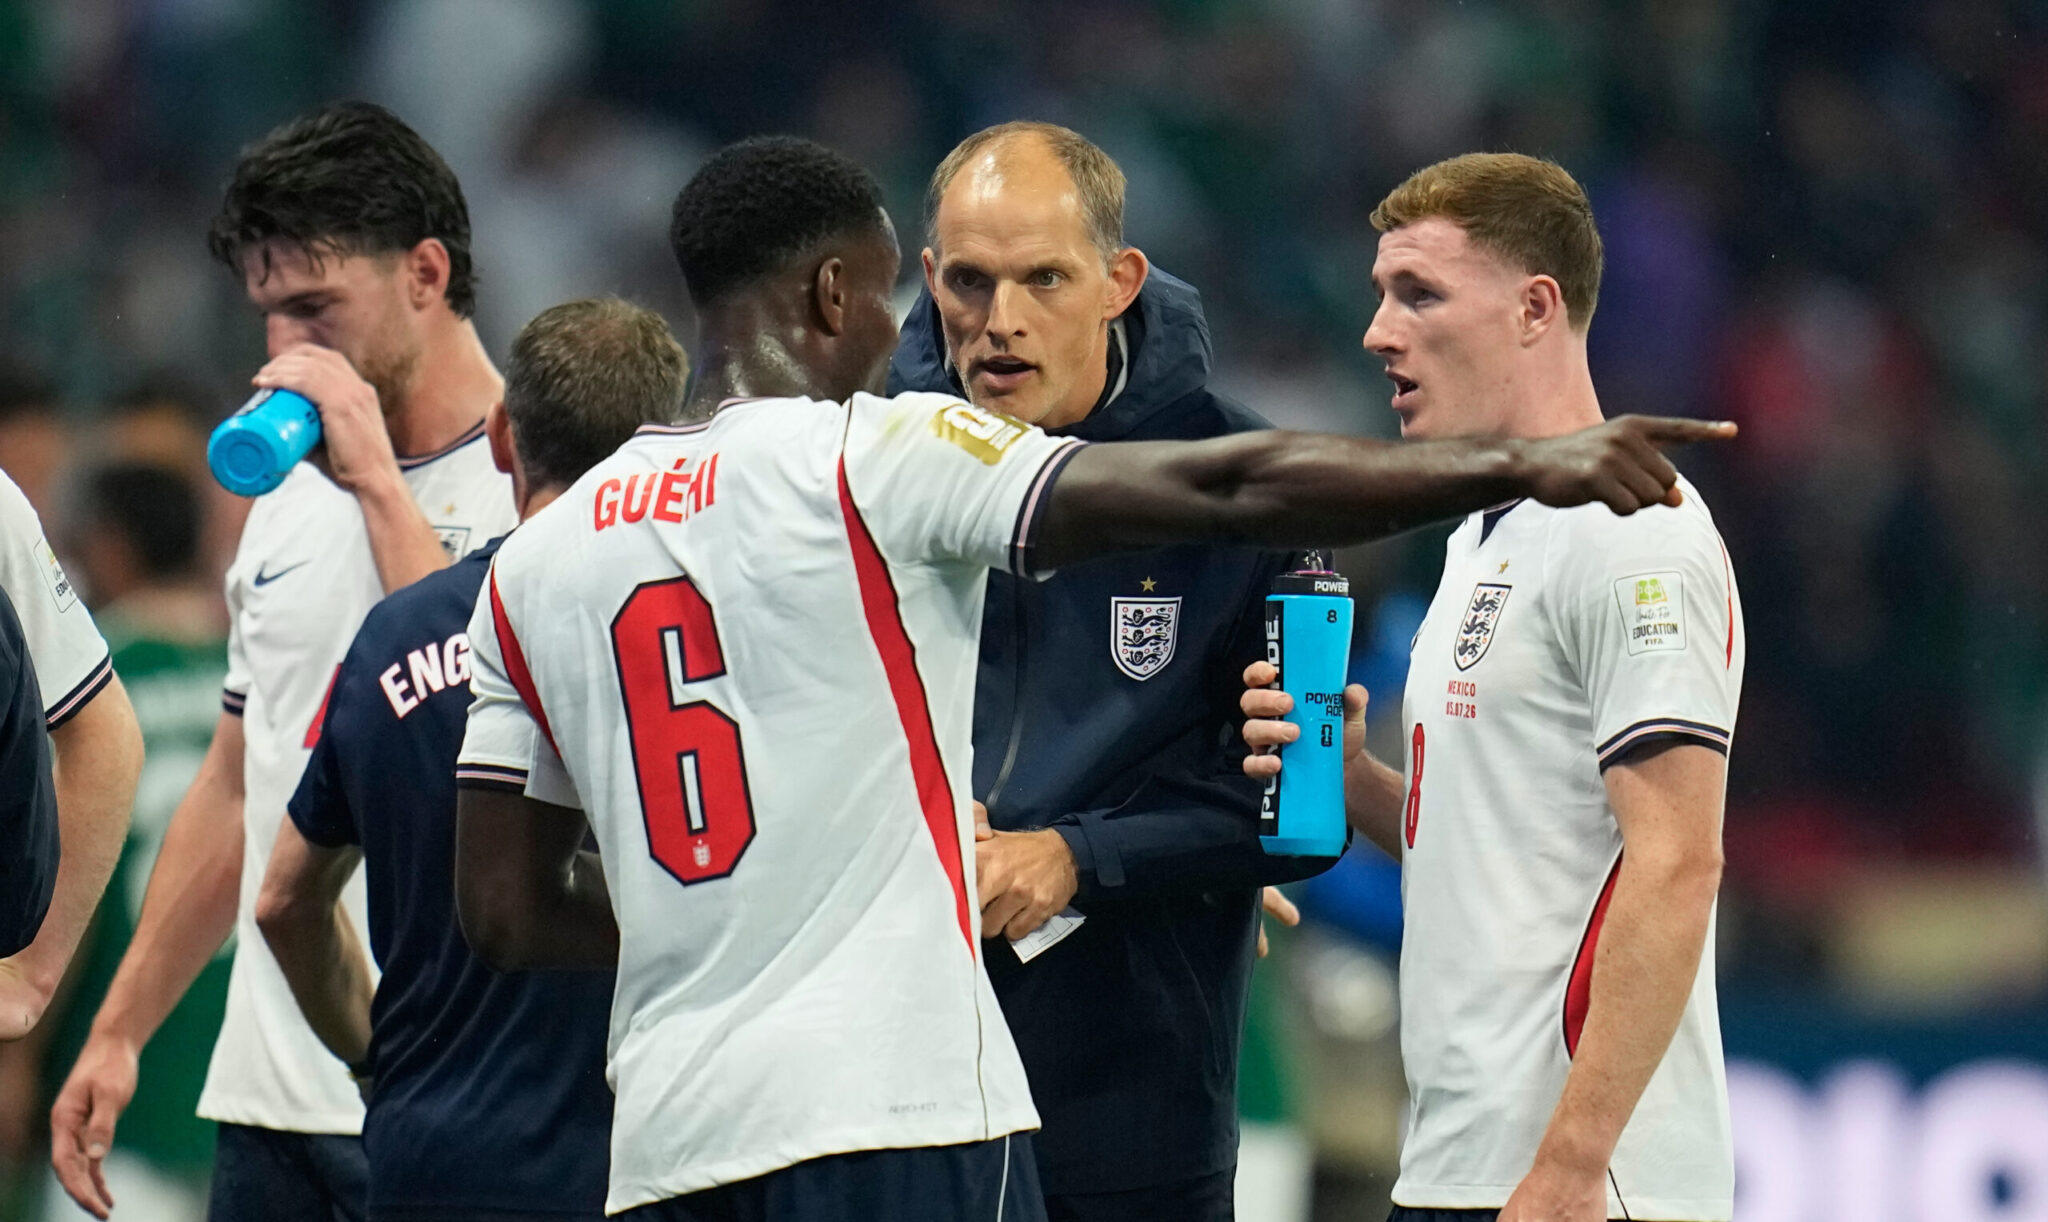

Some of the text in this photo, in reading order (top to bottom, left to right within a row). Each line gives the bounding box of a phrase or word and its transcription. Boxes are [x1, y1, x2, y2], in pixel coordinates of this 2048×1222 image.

[1327, 609, 1337, 624] 8
[1633, 622, 1679, 640] EDUCATION
[1447, 680, 1476, 697] MEXICO
[610, 574, 757, 887] 6
[1405, 723, 1425, 849] 8
